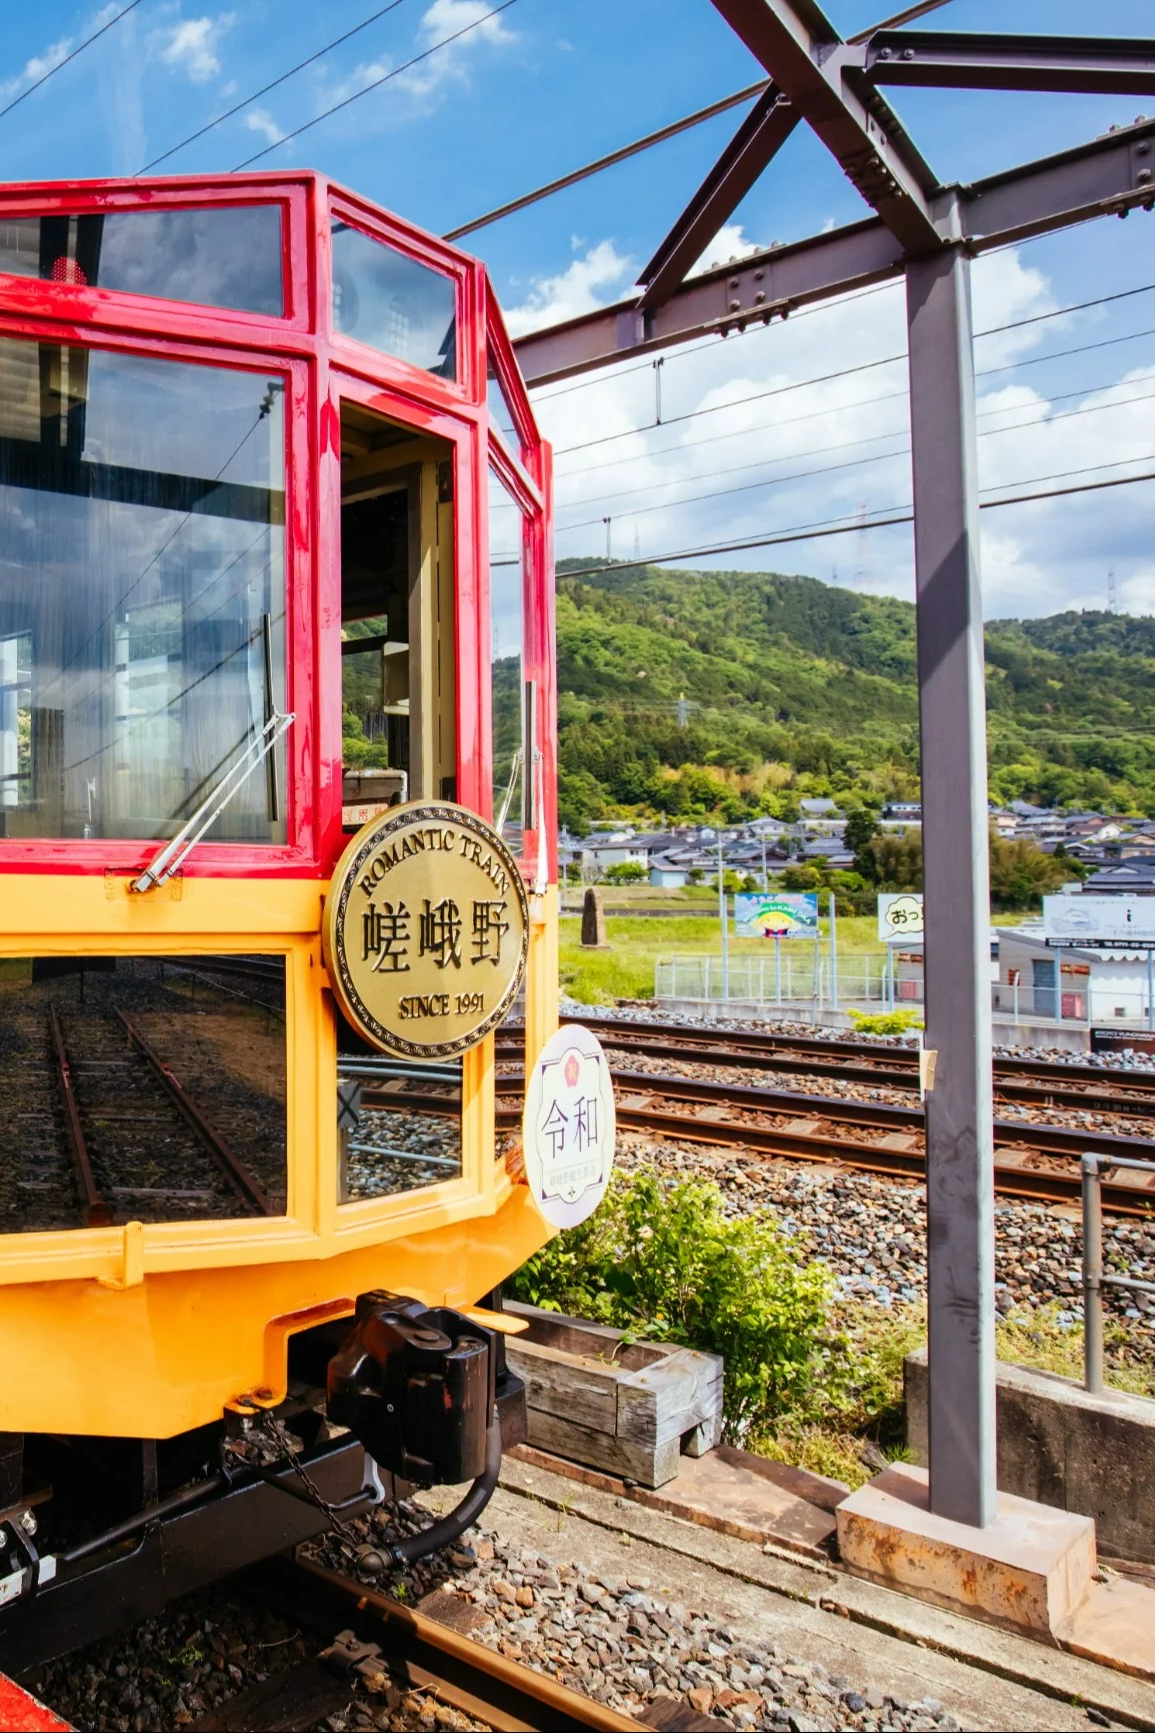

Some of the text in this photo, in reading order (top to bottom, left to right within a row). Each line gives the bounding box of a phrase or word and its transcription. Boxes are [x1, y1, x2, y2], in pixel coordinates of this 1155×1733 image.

[357, 827, 510, 898] ROMANTIC TRAIN
[361, 898, 510, 974] 嵯峨野
[891, 906, 924, 925] おっ
[398, 993, 485, 1019] SINCE 1991
[541, 1096, 598, 1159] 令和
